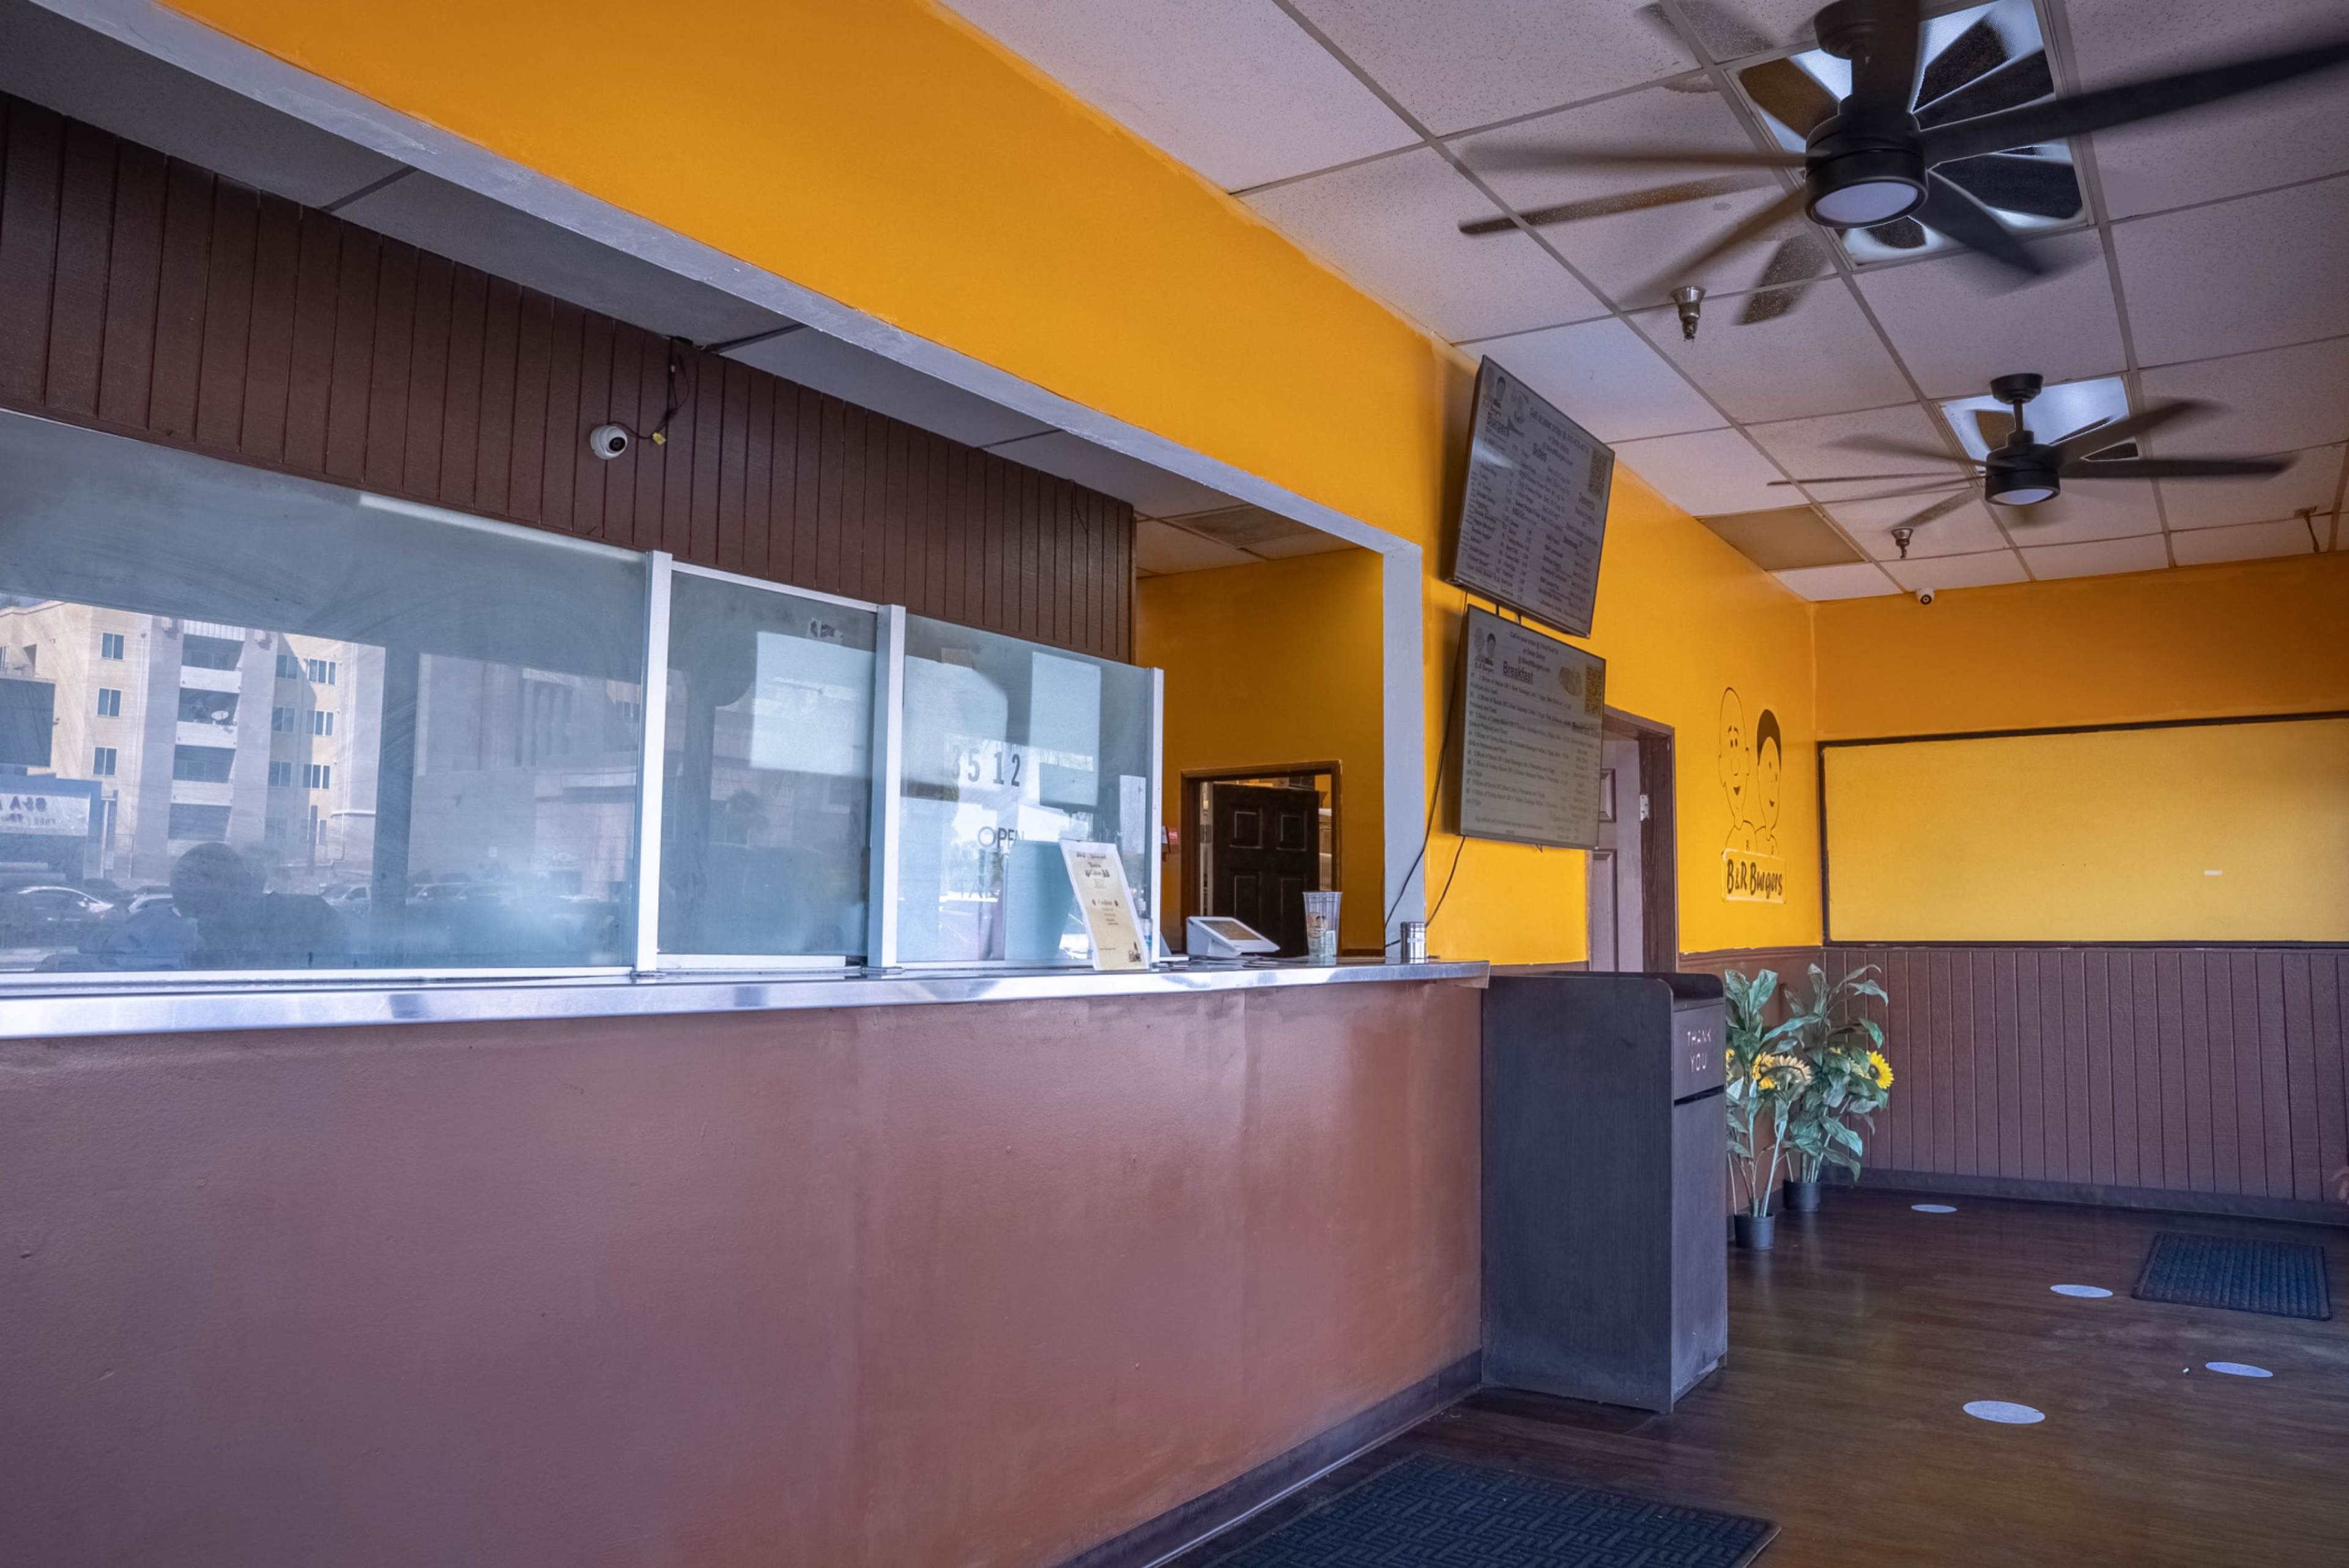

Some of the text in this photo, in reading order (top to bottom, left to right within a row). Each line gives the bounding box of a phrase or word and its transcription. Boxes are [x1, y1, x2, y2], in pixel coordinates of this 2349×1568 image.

[1502, 659, 1533, 685] Breakfast
[1727, 859, 1783, 900] B&R Burgers
[1687, 1028, 1712, 1048] THANK
[1690, 1052, 1707, 1073] YOU
